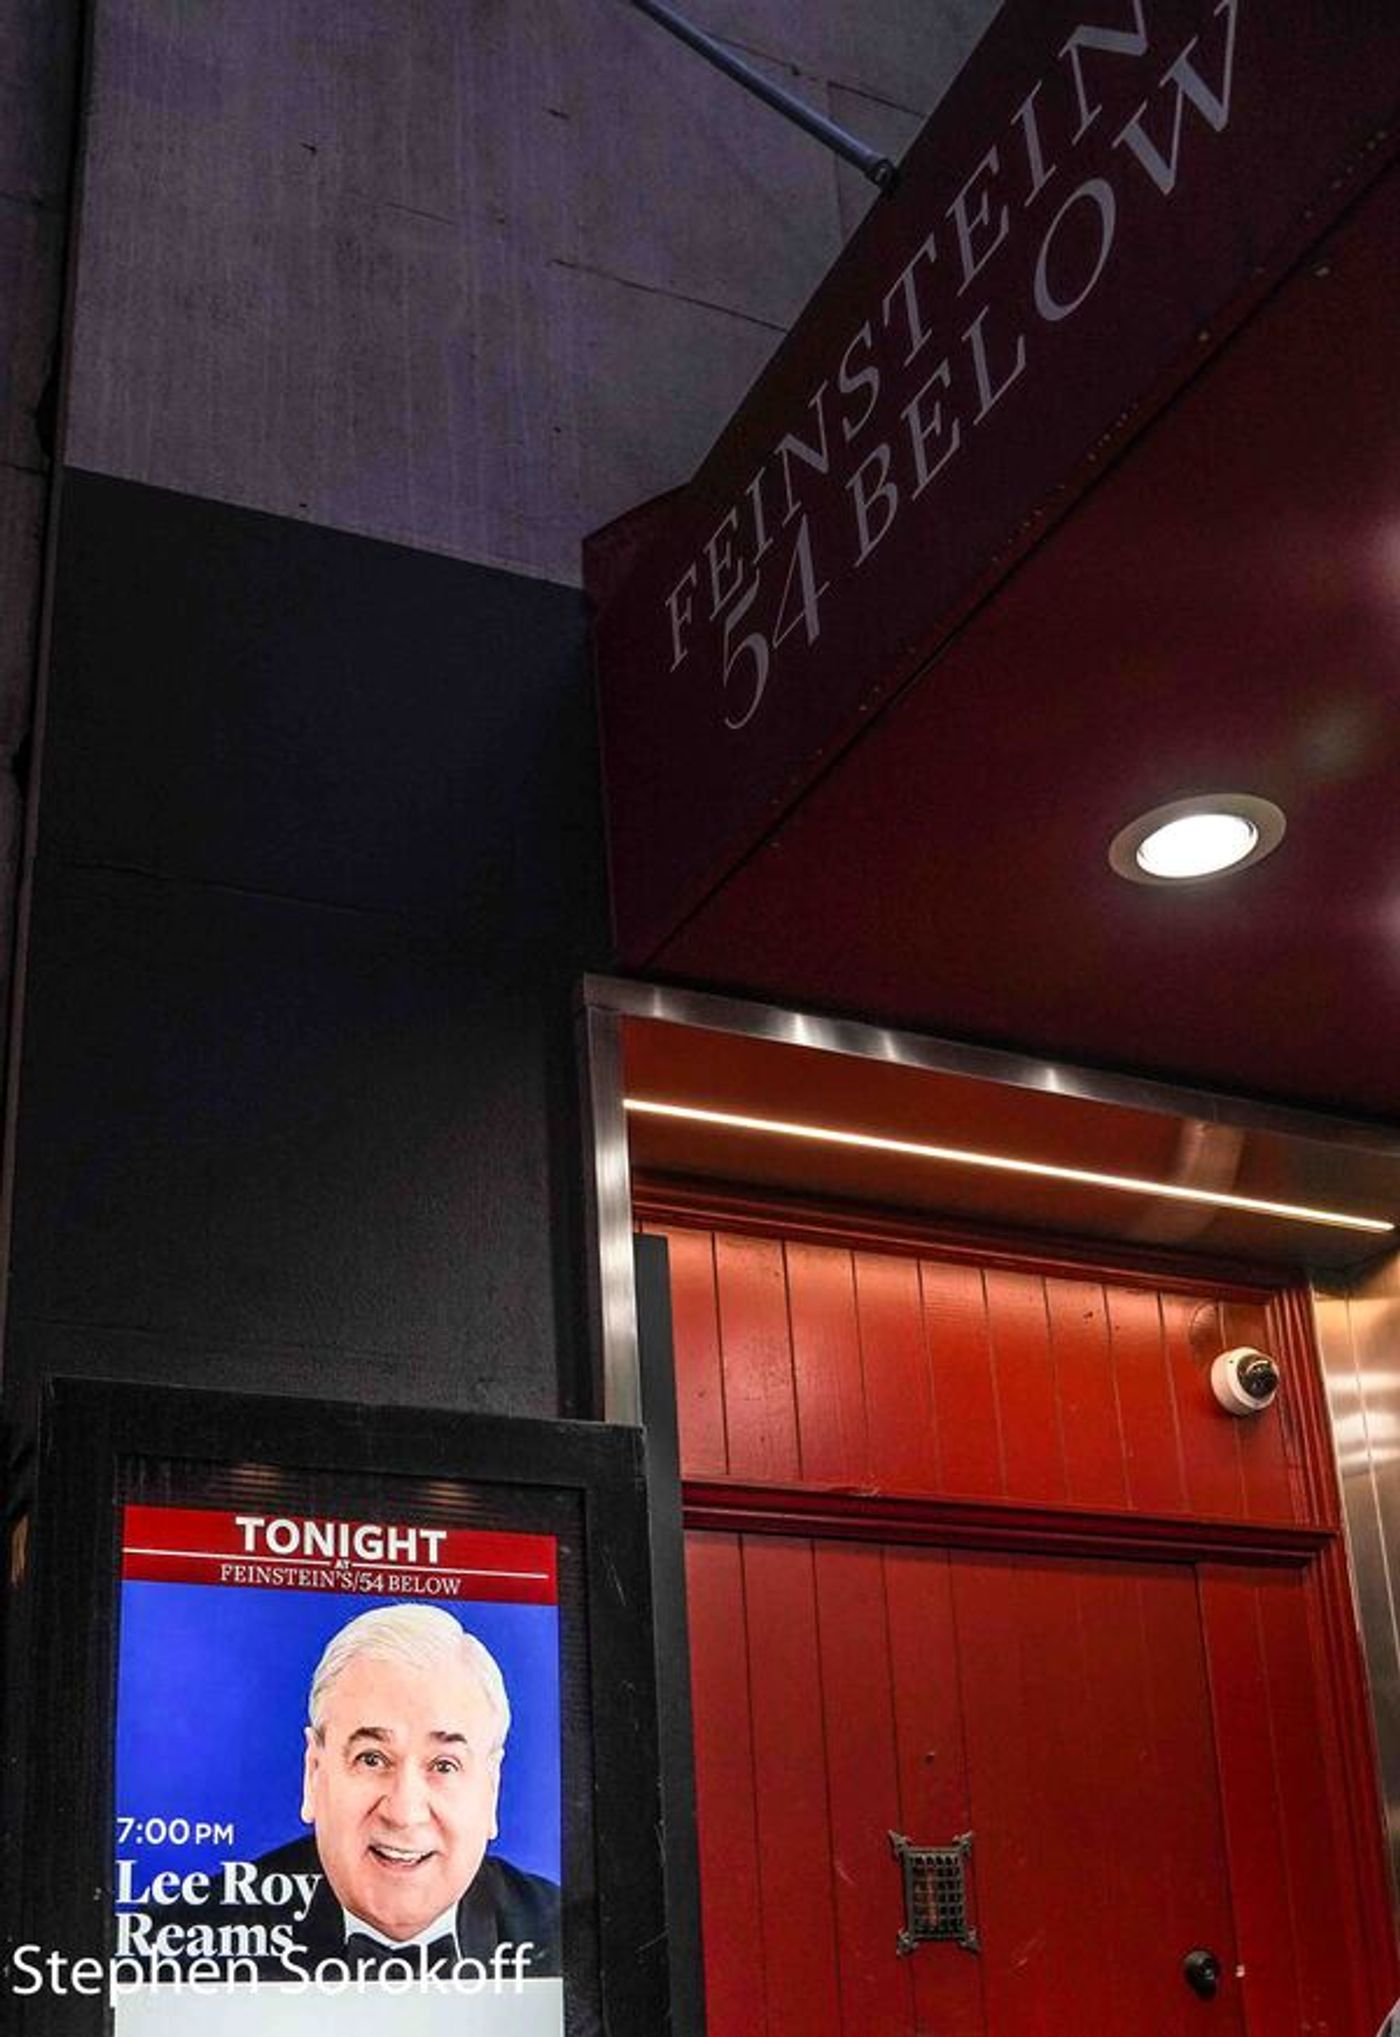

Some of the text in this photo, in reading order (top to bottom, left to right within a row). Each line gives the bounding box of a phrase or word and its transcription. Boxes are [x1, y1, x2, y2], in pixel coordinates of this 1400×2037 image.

[724, 0, 1238, 729] 54 BELOW
[235, 1516, 448, 1564] TONIGHT
[220, 1563, 462, 1596] FEINSTEIN'S/54 BELOW
[116, 1816, 235, 1846] 7:00 PM
[114, 1858, 324, 1922] Lee Roy
[114, 1911, 295, 1958] Reams
